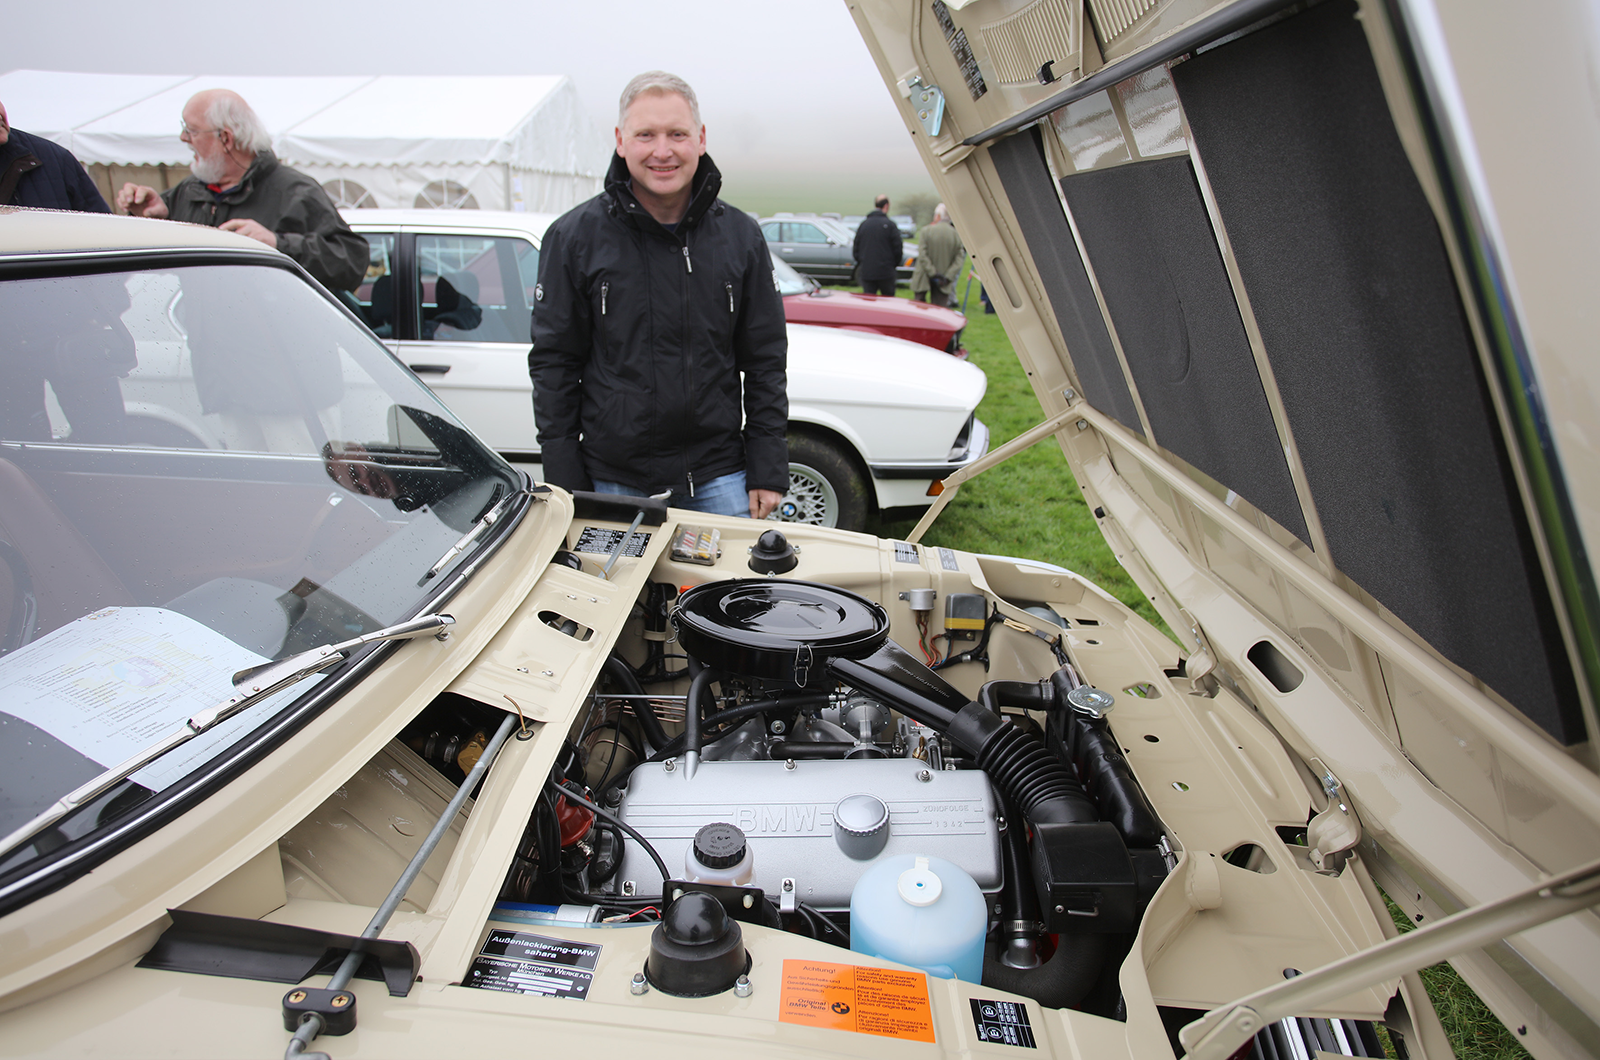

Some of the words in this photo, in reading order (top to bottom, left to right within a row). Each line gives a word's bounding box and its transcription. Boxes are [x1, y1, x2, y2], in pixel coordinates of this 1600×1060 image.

[738, 805, 818, 833] BMW
[524, 949, 557, 959] sahara
[803, 966, 836, 974] Achtung!
[797, 998, 827, 1006] Original
